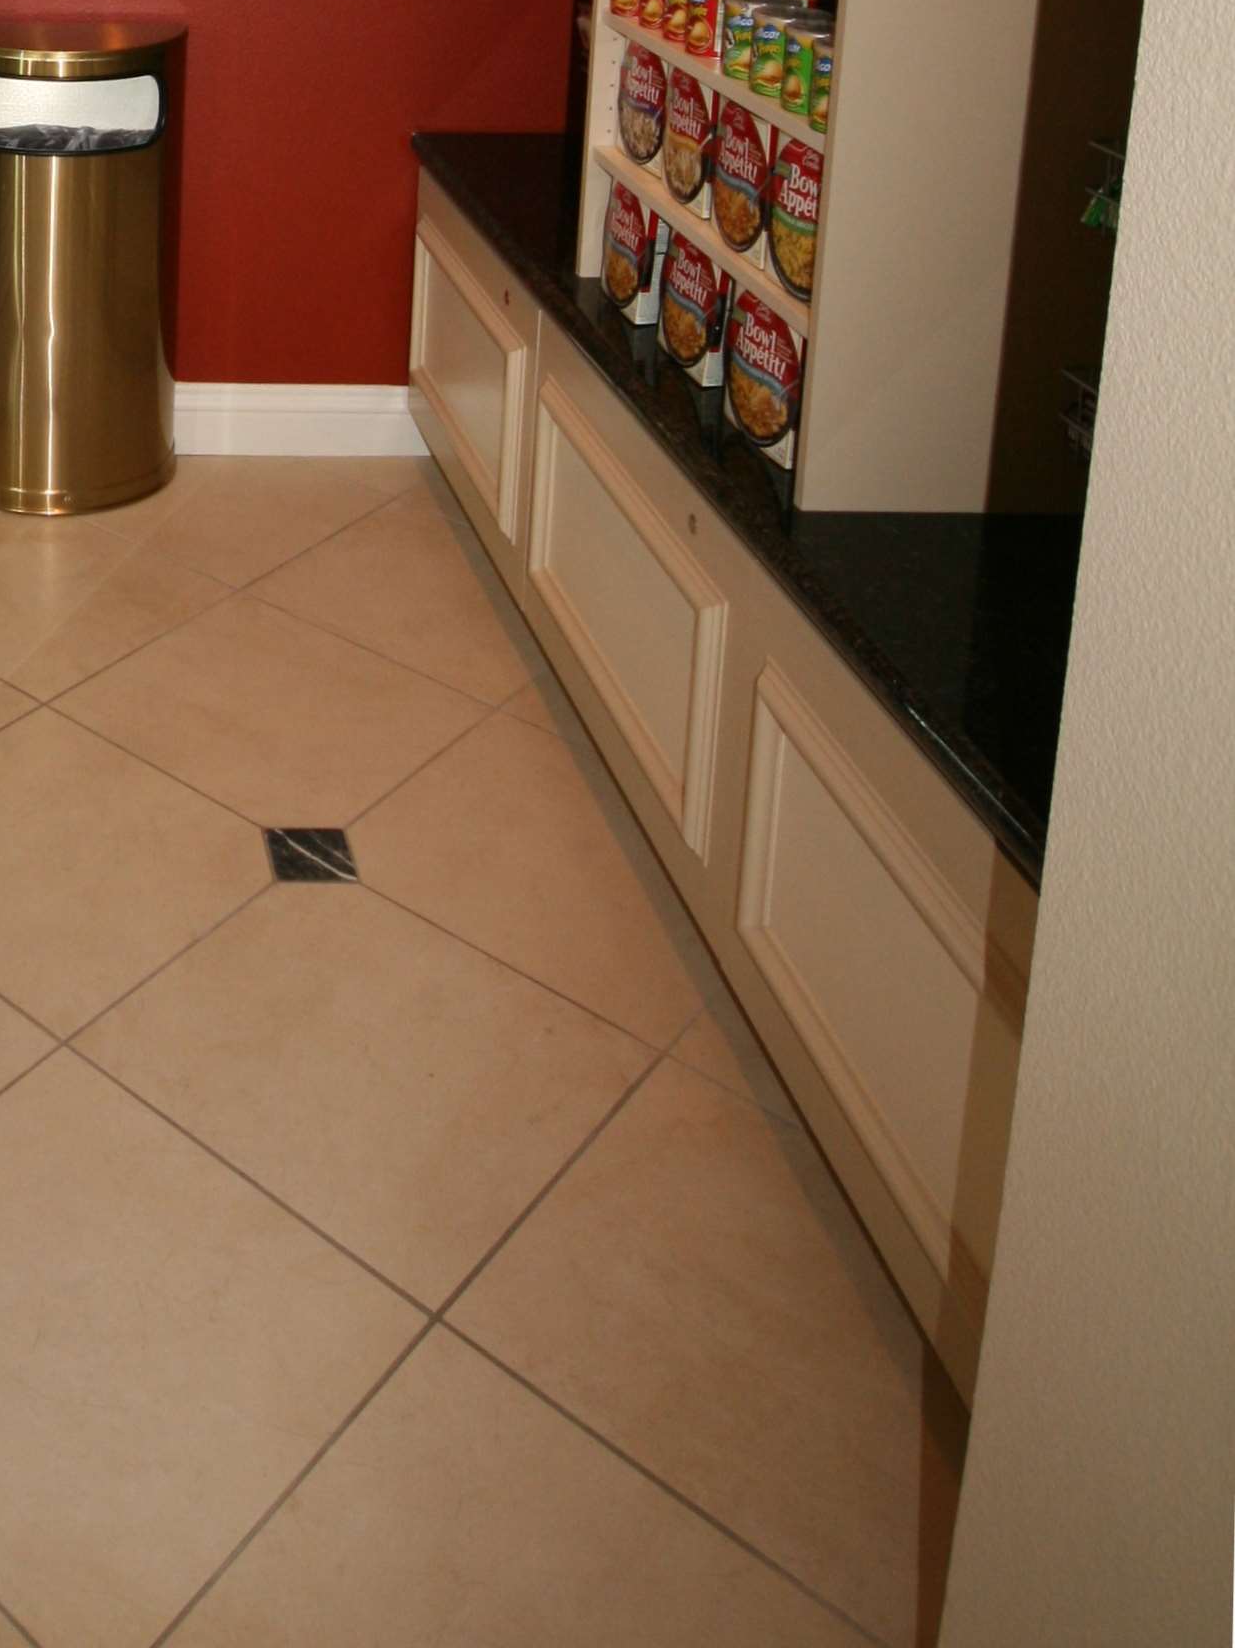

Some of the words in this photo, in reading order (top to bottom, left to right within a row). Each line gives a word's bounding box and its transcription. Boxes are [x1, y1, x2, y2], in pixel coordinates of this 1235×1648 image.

[725, 124, 750, 160] Bowl
[677, 248, 702, 285] Bowl
[745, 311, 777, 353] Bowl
[735, 325, 786, 381] Appétit!
